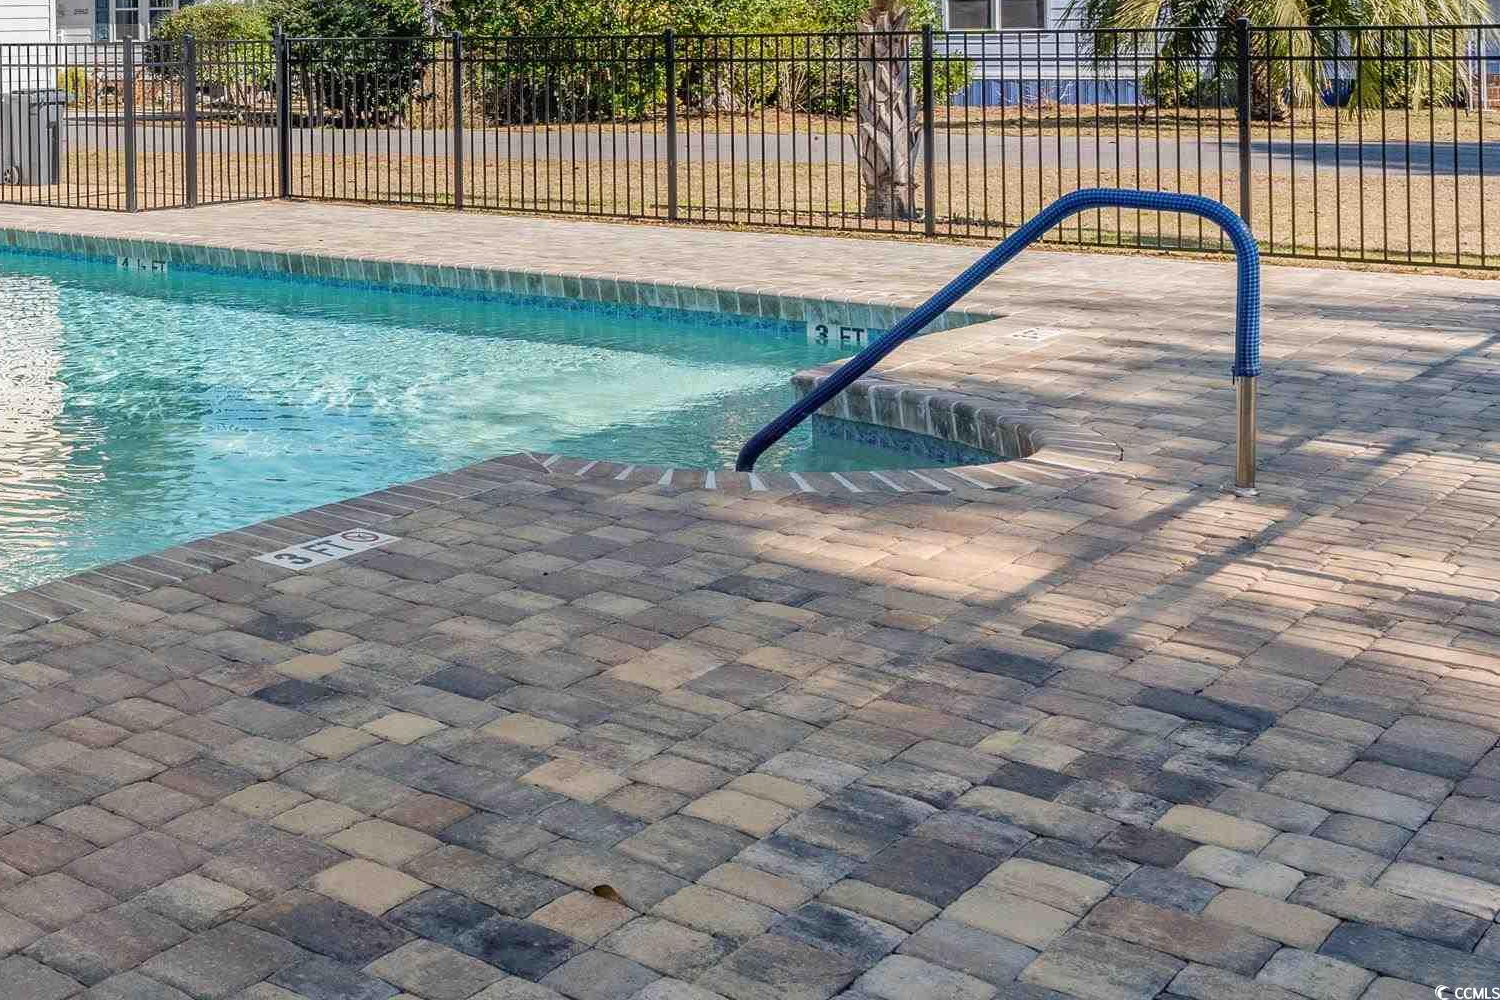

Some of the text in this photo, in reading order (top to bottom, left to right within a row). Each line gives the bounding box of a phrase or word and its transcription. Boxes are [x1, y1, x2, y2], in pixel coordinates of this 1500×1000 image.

[815, 324, 865, 347] 3 FT
[273, 539, 354, 565] 3 FT
